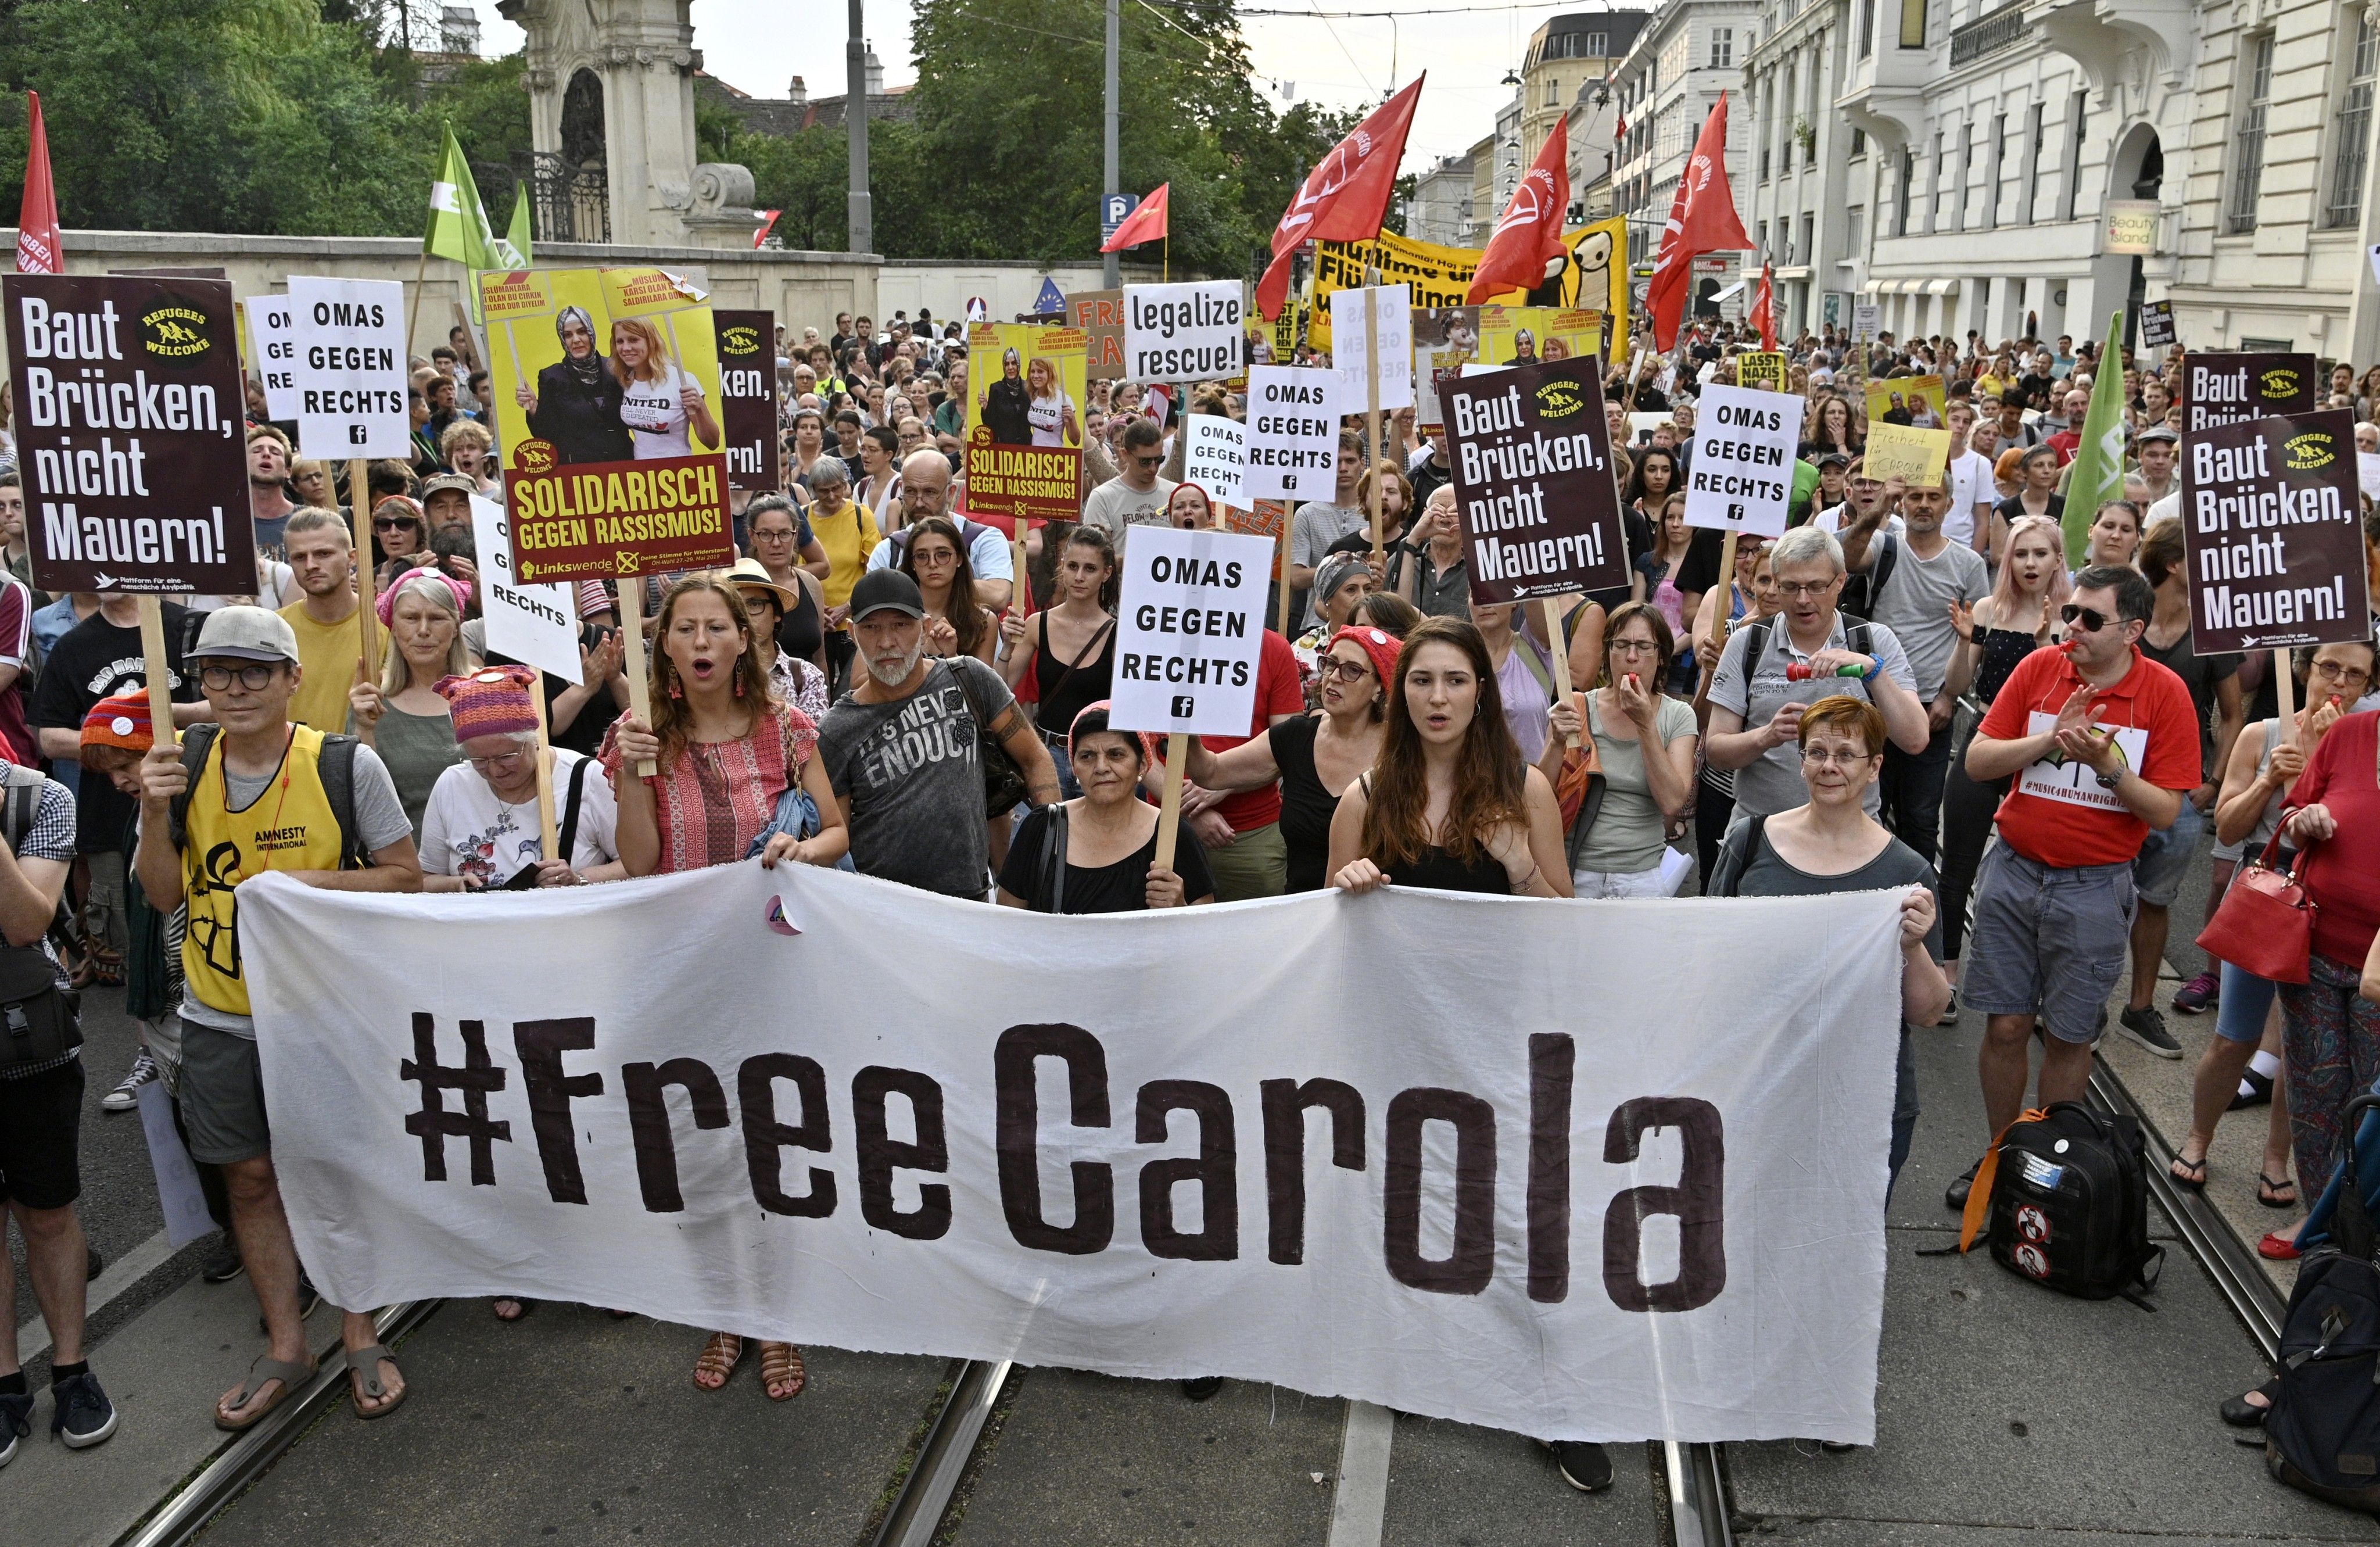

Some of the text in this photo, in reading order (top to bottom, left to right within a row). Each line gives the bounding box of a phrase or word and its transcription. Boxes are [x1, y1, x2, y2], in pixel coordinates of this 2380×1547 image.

[1526, 169, 1554, 193] JUGEND
[1110, 202, 1126, 223] P
[2110, 216, 2156, 229] Beauty
[489, 293, 506, 303] OLAN
[648, 284, 666, 293] OLAN
[142, 308, 206, 326] REFUGEES
[314, 302, 384, 328] OMAS
[1133, 292, 1239, 338] legalize
[21, 297, 123, 360] Baut
[722, 326, 758, 338] REFUGEES
[146, 338, 210, 356] WELCOME
[724, 344, 759, 354] WELCOME
[1138, 336, 1236, 377] rescue!
[309, 346, 393, 371] GEGEN
[1742, 354, 1779, 366] LASST
[1742, 367, 1779, 378] NAZIS
[2260, 369, 2298, 381] REFUGEES
[1266, 384, 1324, 404] OMAS
[1536, 381, 1580, 400] REFUGEES
[2192, 366, 2248, 402] Baut
[2261, 386, 2300, 399] WELCOME
[28, 367, 232, 438] Brücken,
[304, 391, 402, 414] RECHTS
[1453, 385, 1525, 438] Baut
[1539, 400, 1583, 417] WELCOME
[626, 414, 658, 422] DEFEATED
[1257, 416, 1327, 437] GEGEN
[1717, 406, 1781, 431] OMAS
[1201, 426, 1242, 445] OMAS
[1872, 427, 1926, 445] Freiheit
[2284, 433, 2332, 451] REFUGEES
[517, 442, 550, 453] REFUGEES
[1195, 446, 1244, 465] GEGEN
[1461, 430, 1603, 486] Brücken,
[1706, 439, 1782, 467] GEGEN
[1869, 445, 1881, 457] für
[35, 436, 149, 497] nicht
[525, 463, 552, 473] WELCOME
[970, 449, 1075, 481] SOLIDARISCH
[1250, 448, 1332, 469] RECHTS
[1878, 458, 1923, 472] CAROLA
[2193, 435, 2270, 485] Baut
[2286, 453, 2335, 470] WELCOME
[1190, 467, 1241, 485] RECHT
[514, 465, 718, 520] SOLIDARISCH
[970, 475, 1075, 499] GEGEN RASSISMUS!
[1694, 472, 1783, 502] RECHTS
[976, 501, 1013, 511] Linkswende
[1468, 482, 1547, 533] nicht
[2196, 481, 2352, 533] Brücken,
[42, 503, 227, 564] Mauern!
[519, 521, 589, 550] GEGEN
[596, 508, 722, 544] RASSISMUS!
[694, 547, 730, 555] Widerstand!
[1475, 522, 1604, 582] Mauern!
[2200, 531, 2286, 582] nicht
[536, 558, 612, 575] Linkswende
[1151, 556, 1242, 588] OMAS
[493, 583, 566, 627] RECHTS
[2203, 575, 2346, 630] Mauern!
[1136, 605, 1246, 638] GEGEN
[88, 666, 115, 694] BAD
[1122, 653, 1248, 686] RECHTS
[255, 826, 306, 843] AMNESTY
[257, 840, 307, 851] INTERNATIONAL
[400, 1012, 1727, 1312] #FreeCarola
